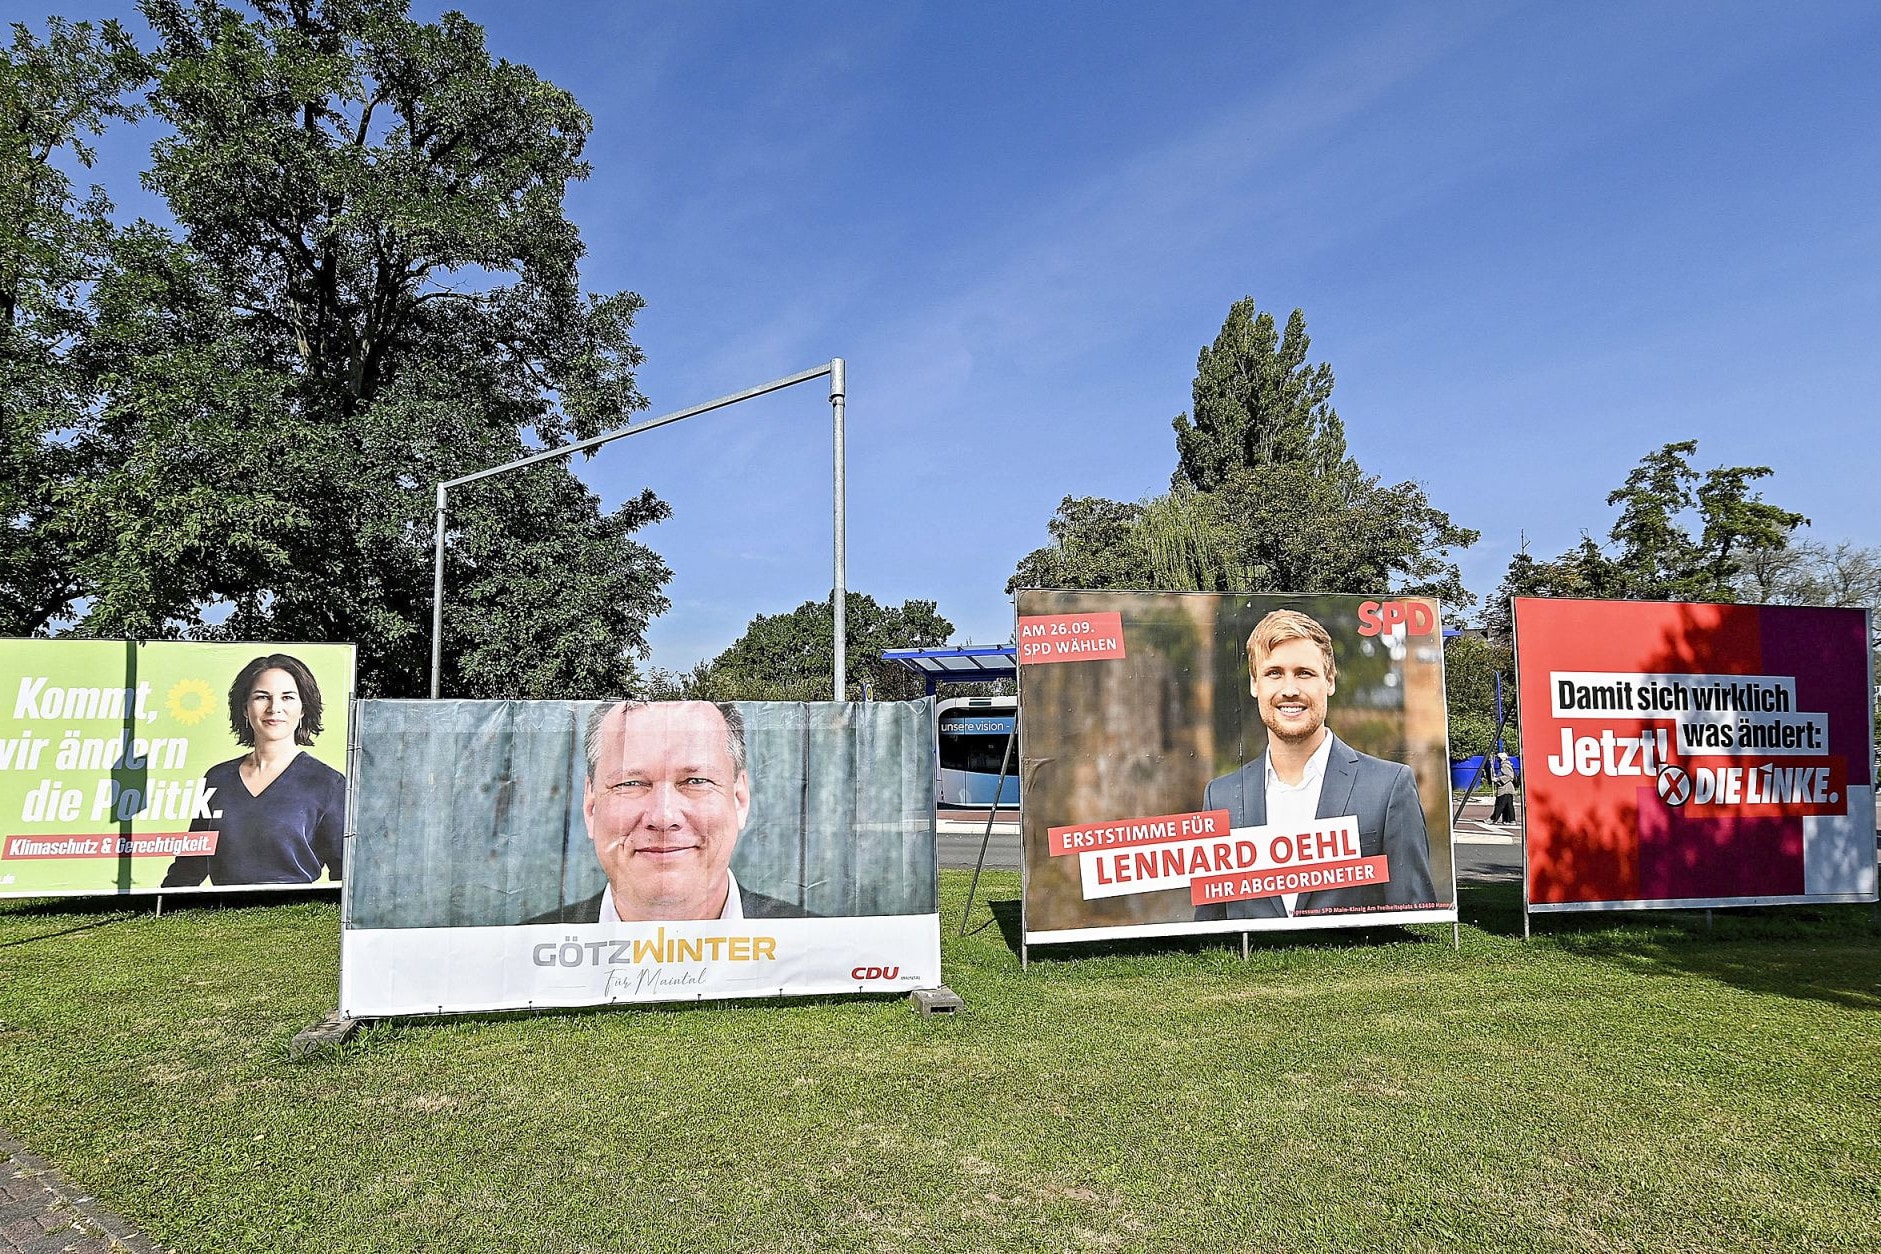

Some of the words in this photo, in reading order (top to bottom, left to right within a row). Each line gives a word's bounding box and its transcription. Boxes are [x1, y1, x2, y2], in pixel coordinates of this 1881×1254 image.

[1022, 624, 1045, 638] AM
[1050, 621, 1095, 636] 26.09.
[1357, 600, 1434, 636] SPD
[1023, 642, 1052, 657] SPD
[1055, 637, 1117, 654] WÄHLEN
[13, 677, 159, 724] Kommt,
[1558, 680, 1632, 711] Damit
[1637, 682, 1688, 711] sich
[1691, 683, 1789, 713] wirklich
[941, 722, 974, 732] unsere
[976, 721, 1004, 731] vision
[1682, 723, 1733, 748] was
[1738, 718, 1822, 749] ändert:
[55, 728, 190, 771] ändern
[1547, 727, 1669, 777] Jetzt!
[21, 780, 82, 822] die
[90, 777, 224, 822] Politik.
[1694, 767, 1742, 805] DIE
[9, 838, 99, 857] Klimaschutz
[101, 837, 111, 854] &
[116, 835, 212, 856] Gerechtigkeit.
[1062, 822, 1177, 849] ERSTSTIMME
[1180, 815, 1215, 836] FÜR
[1096, 840, 1258, 886] LENNARD
[1269, 829, 1357, 865] OEHL
[1204, 881, 1235, 899] IHR
[1240, 865, 1375, 895] ABGEORDNETER
[603, 968, 631, 997] Für
[634, 967, 707, 995] Maintal
[851, 966, 899, 980] CDU
